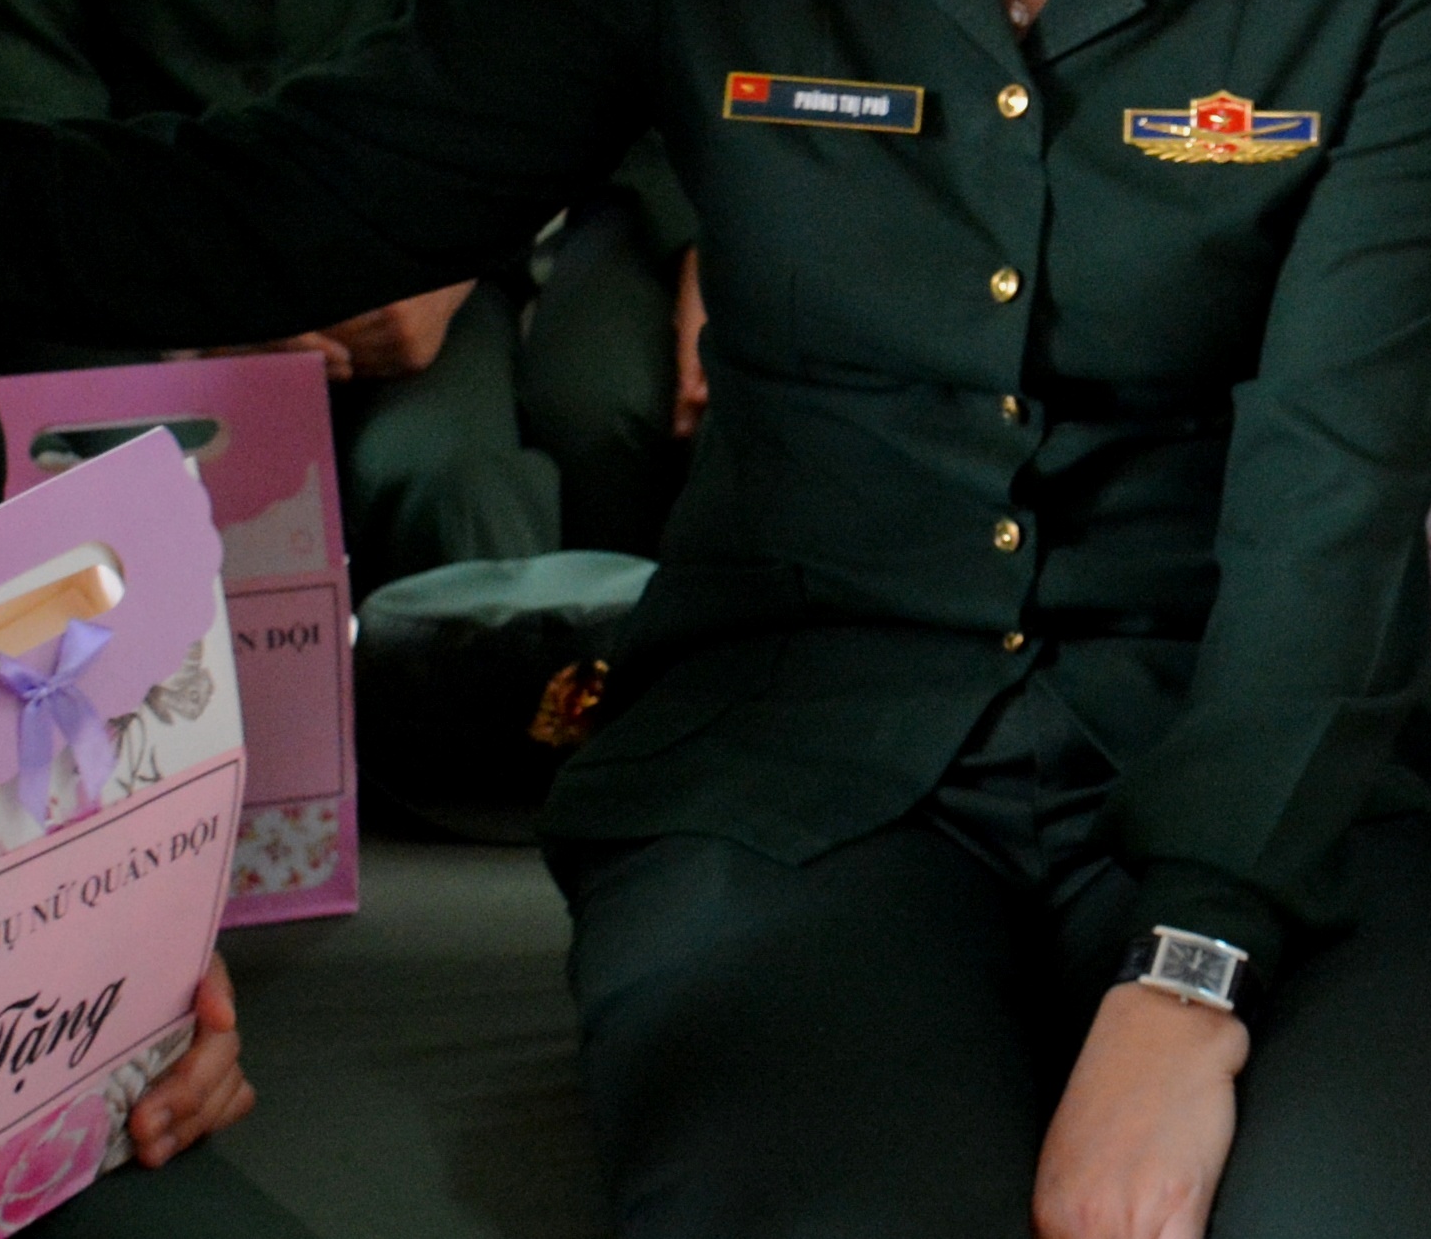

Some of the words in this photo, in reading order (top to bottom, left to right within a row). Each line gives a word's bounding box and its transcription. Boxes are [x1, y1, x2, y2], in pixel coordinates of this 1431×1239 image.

[29, 880, 77, 935] NỮ
[80, 843, 163, 908] QUÂN
[169, 814, 221, 863] ĐỘI
